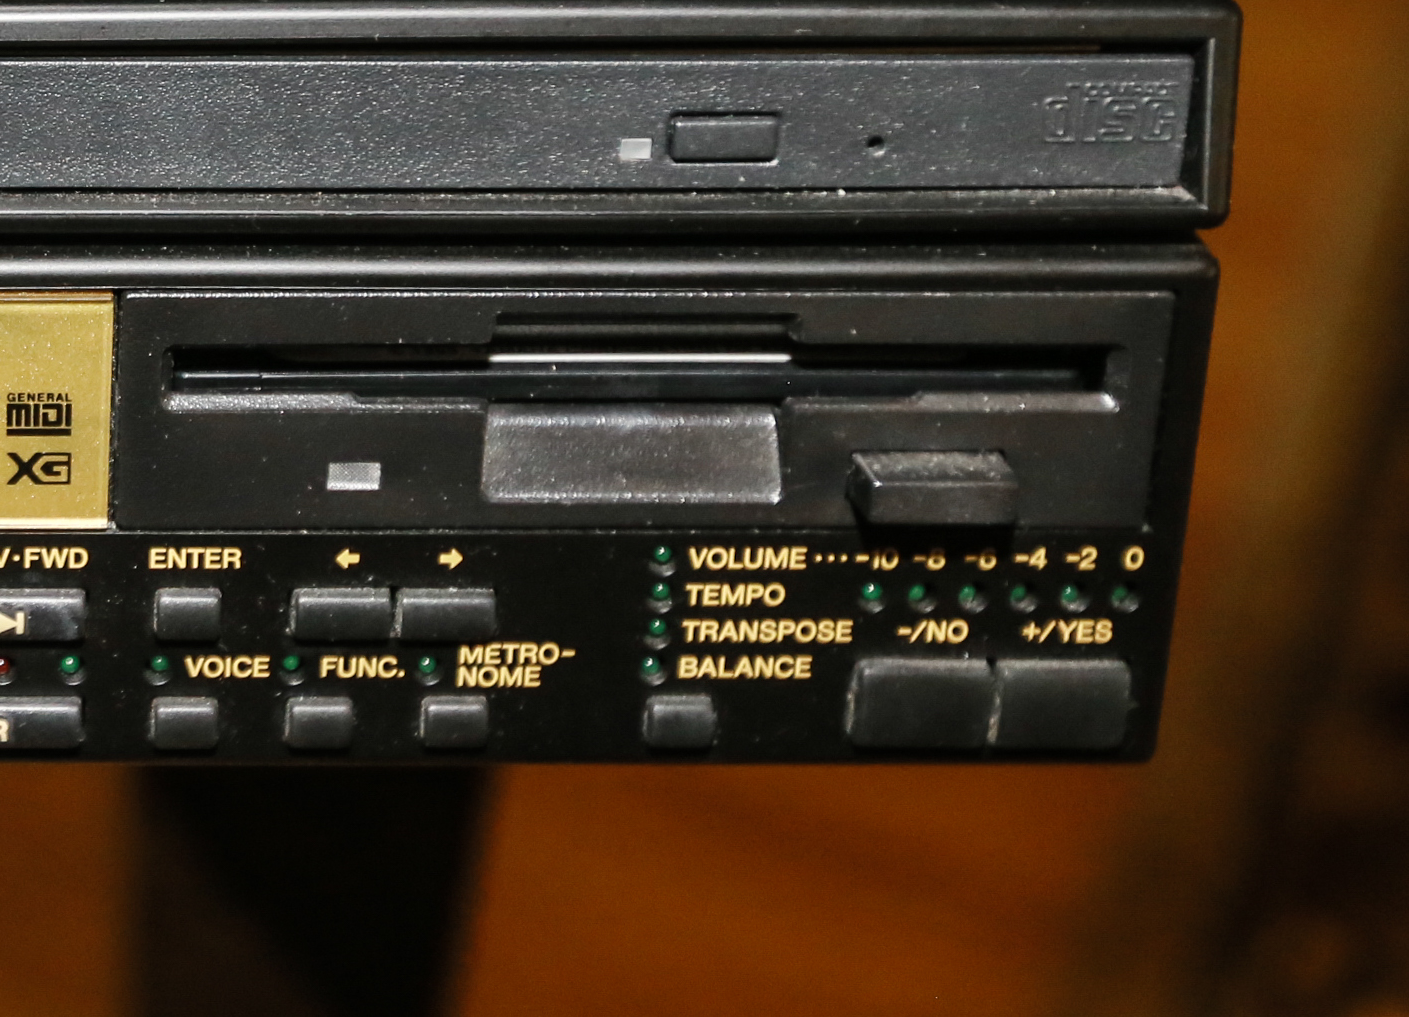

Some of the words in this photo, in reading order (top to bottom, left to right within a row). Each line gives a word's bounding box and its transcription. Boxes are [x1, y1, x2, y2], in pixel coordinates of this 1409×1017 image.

[6, 392, 72, 403] GENERAL
[6, 452, 72, 485] XG
[148, 547, 242, 570] ENTER
[689, 547, 808, 571] VOLUME
[1014, 547, 1047, 571] -4
[1065, 547, 1098, 571] -2
[1122, 547, 1145, 571] 0
[686, 583, 786, 607] TEMPO
[681, 619, 854, 644] TRANSPOSE
[896, 619, 969, 644] -/NO
[1021, 619, 1113, 644] +/YES
[458, 642, 576, 666] METRO-
[185, 656, 271, 679] VOICE
[319, 656, 406, 679] FUNC.
[456, 666, 542, 688] NOME
[678, 655, 813, 680] BALANCE
